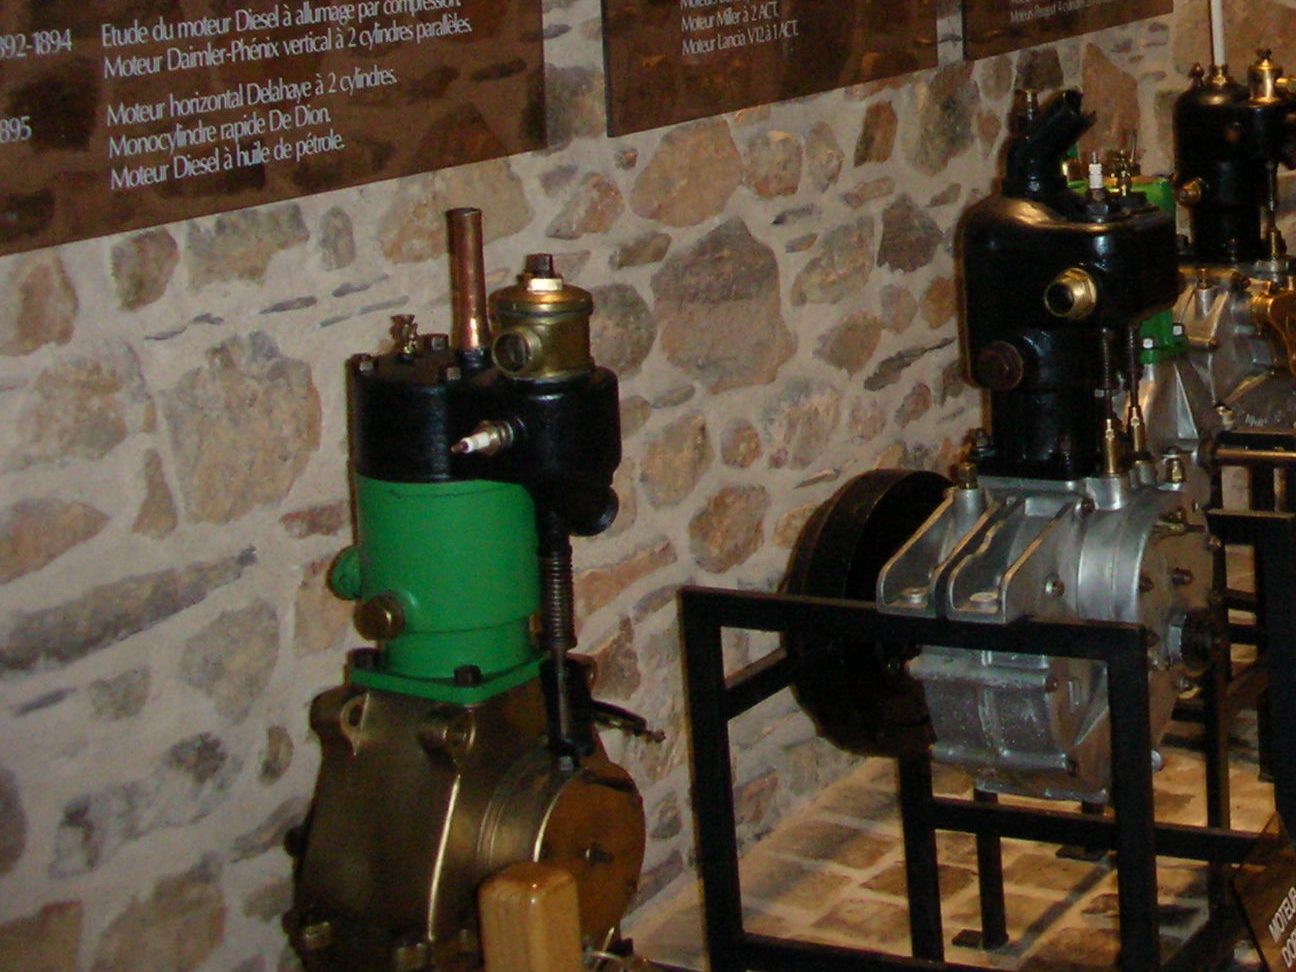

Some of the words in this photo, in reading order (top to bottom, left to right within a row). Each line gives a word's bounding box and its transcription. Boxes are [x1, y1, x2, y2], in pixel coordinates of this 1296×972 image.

[100, 22, 149, 45] Etude
[151, 19, 174, 40] du
[177, 17, 232, 36] moteur
[235, 7, 280, 30] Diesel
[282, 5, 292, 25] à
[295, 4, 355, 24] allumage
[357, 1, 380, 19] par
[102, 56, 163, 76] Moteur
[167, 38, 278, 67] Daimler-Phénix
[282, 30, 332, 53] vertical
[334, 28, 344, 47] à
[347, 27, 356, 46] 2
[359, 23, 414, 45] cylindres
[416, 15, 472, 39] parallèles.
[105, 103, 165, 125] Moteur
[169, 87, 244, 115] horizontal
[246, 81, 312, 105] Delahaye
[314, 74, 324, 95] à
[327, 72, 337, 93] 2
[339, 68, 398, 92] cylindres.
[108, 124, 216, 157] Monocylindre
[220, 114, 266, 140] rapide
[268, 109, 292, 130] De
[294, 105, 331, 126] Dion.
[110, 165, 169, 188] Moteur
[173, 150, 220, 177] Diesel
[222, 147, 233, 169] à
[236, 142, 271, 166] huile
[273, 138, 293, 160] de
[295, 131, 345, 158] pétrole.
